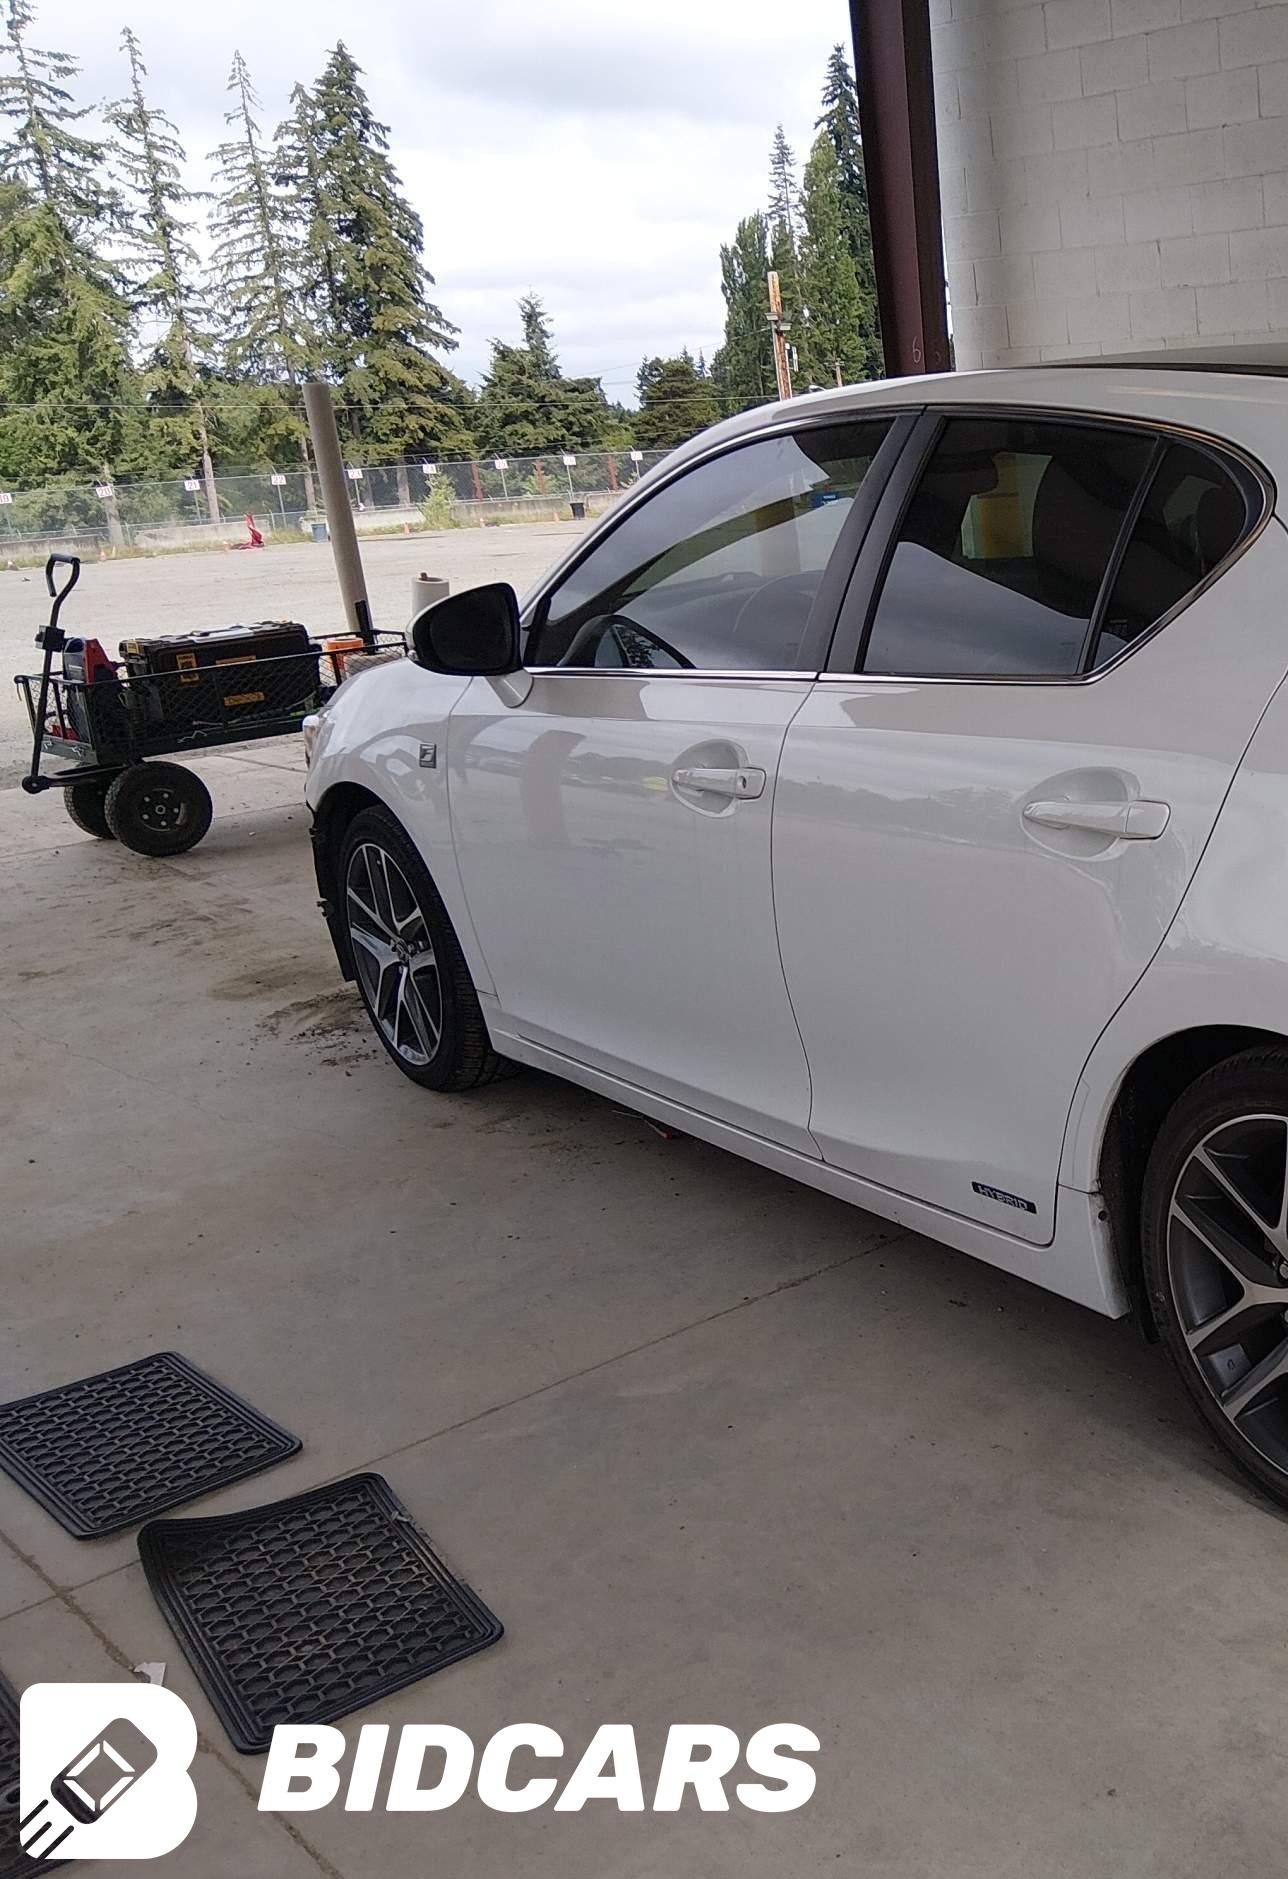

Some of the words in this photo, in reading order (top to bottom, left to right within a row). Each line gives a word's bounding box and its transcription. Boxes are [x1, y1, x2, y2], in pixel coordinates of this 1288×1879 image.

[187, 480, 197, 490] 21
[98, 487, 111, 496] 20
[976, 1184, 1029, 1210] HYBRID
